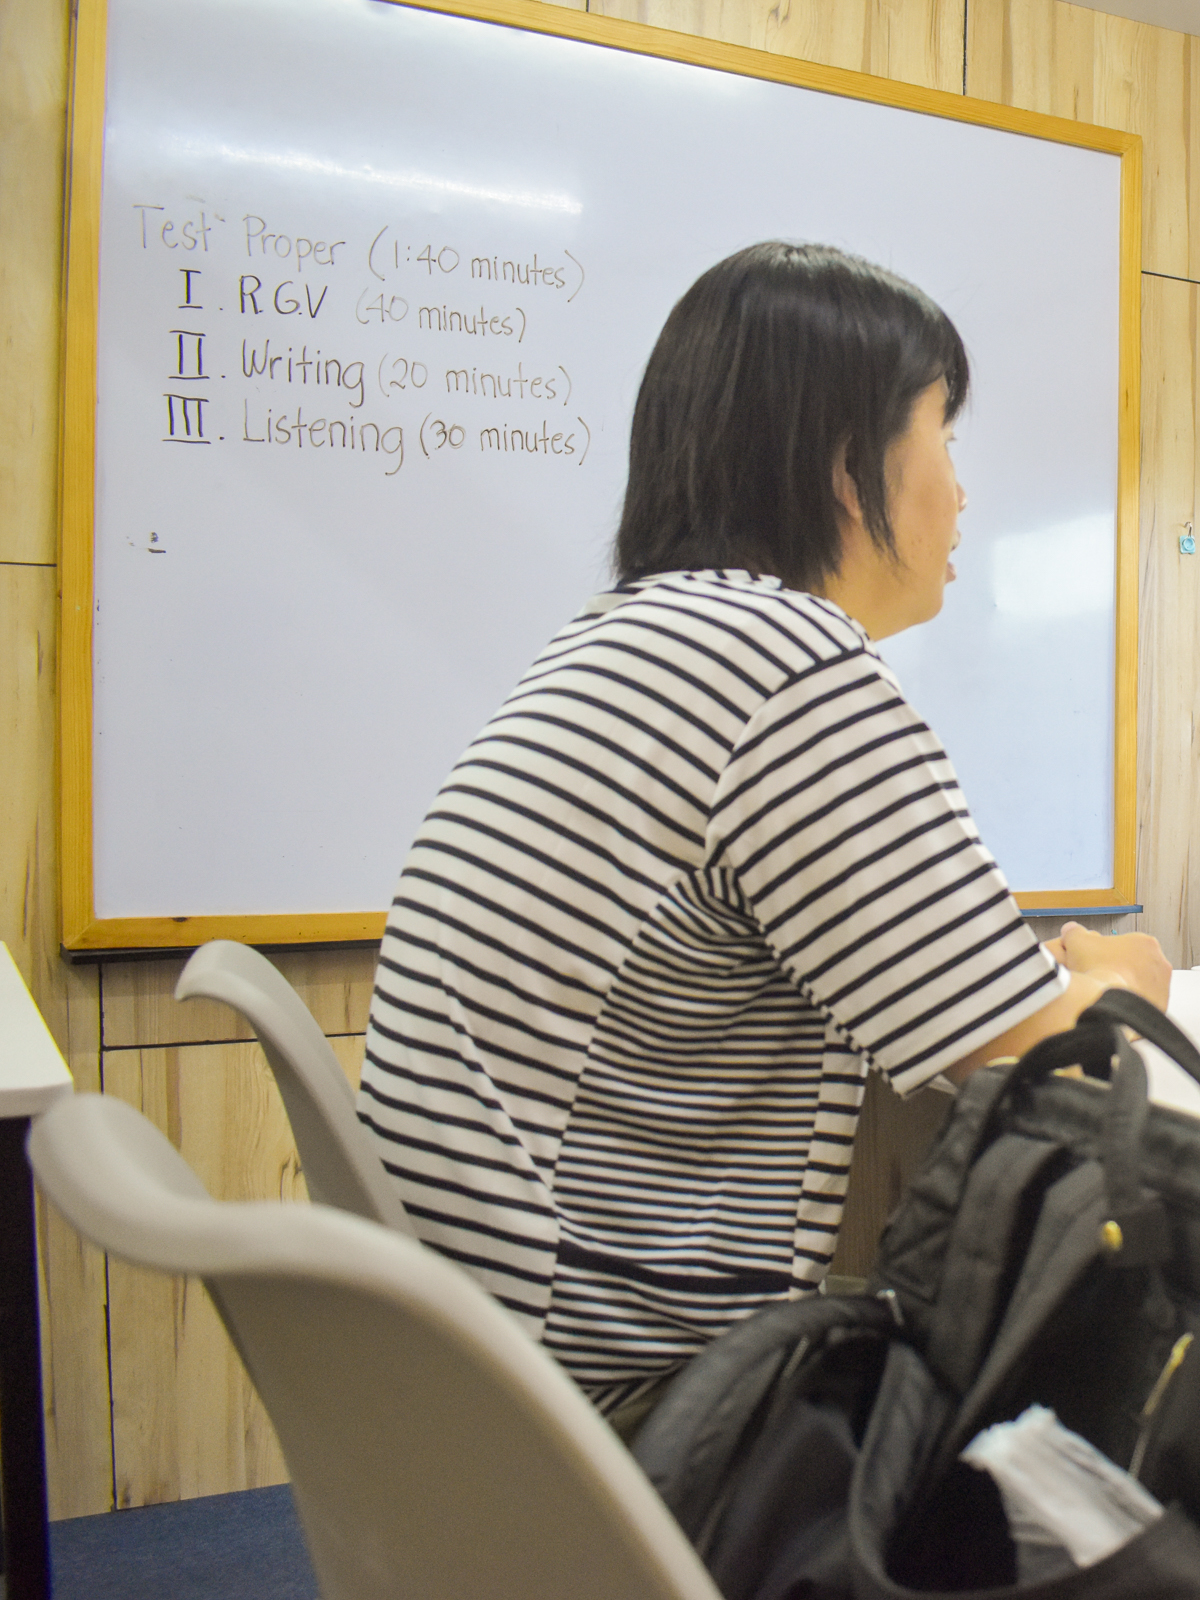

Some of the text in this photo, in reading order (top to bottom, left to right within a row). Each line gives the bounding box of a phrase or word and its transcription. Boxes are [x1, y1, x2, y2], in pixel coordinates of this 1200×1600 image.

[132, 204, 586, 303] Test Proper (1:40 minutes)
[418, 304, 527, 344] minutes)
[241, 338, 366, 408] Writing
[378, 351, 429, 399] (20
[445, 364, 573, 407] minutes)
[242, 398, 405, 476] Listening
[419, 411, 467, 460] (30
[479, 415, 593, 467] minutes)
